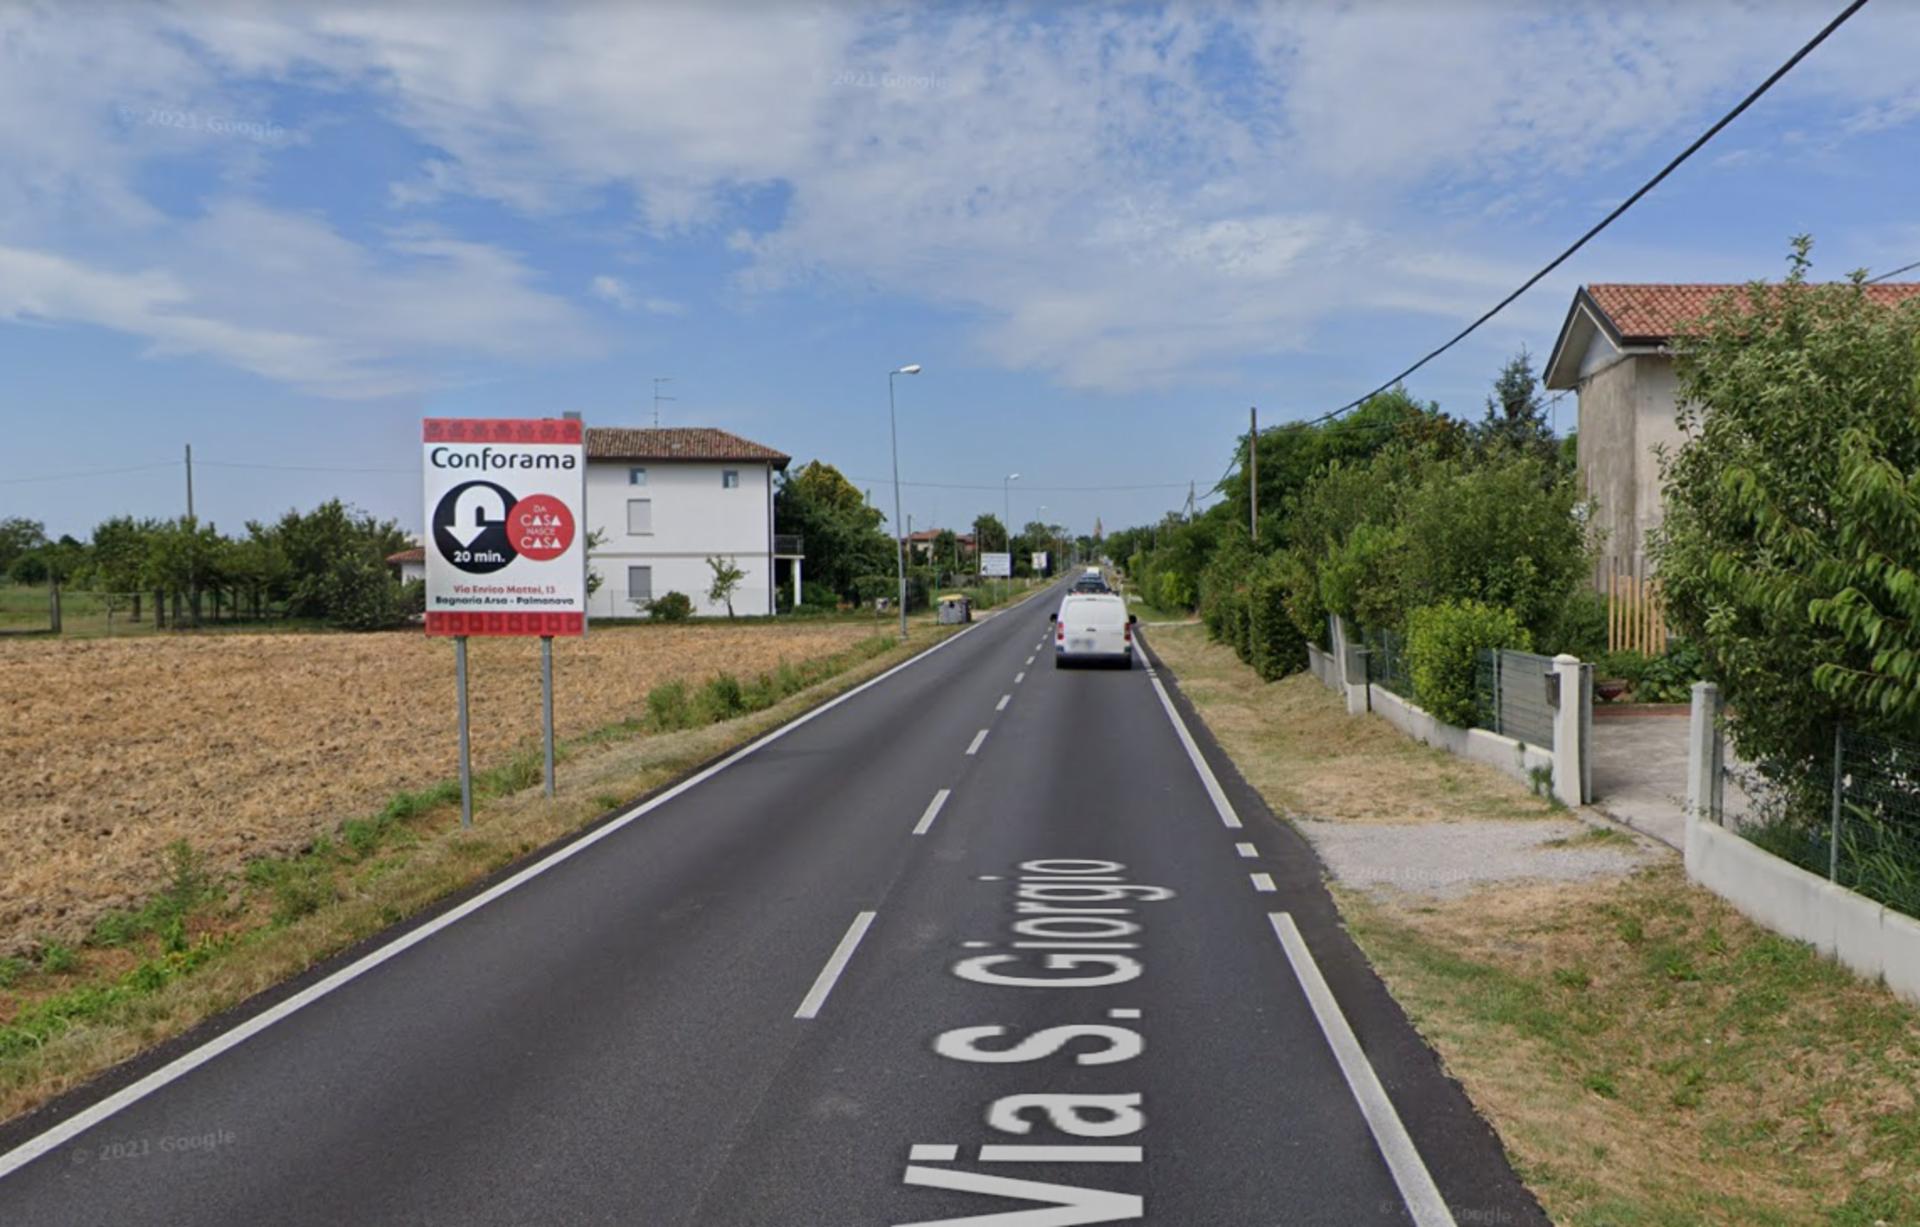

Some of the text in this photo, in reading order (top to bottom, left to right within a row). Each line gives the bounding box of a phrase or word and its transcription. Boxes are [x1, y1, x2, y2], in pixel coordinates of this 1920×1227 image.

[431, 447, 576, 471] Conforama
[533, 504, 547, 513] DA
[520, 513, 562, 527] CASA
[526, 527, 555, 536] NASCE
[520, 536, 562, 549] CASA
[453, 549, 506, 563] 20 min.
[453, 585, 470, 594] Via
[472, 584, 504, 594] Enrico
[506, 585, 544, 595] Mattei,
[435, 595, 483, 606] Bagnaria
[484, 596, 508, 605] Arsa
[516, 596, 575, 605] Palmanova
